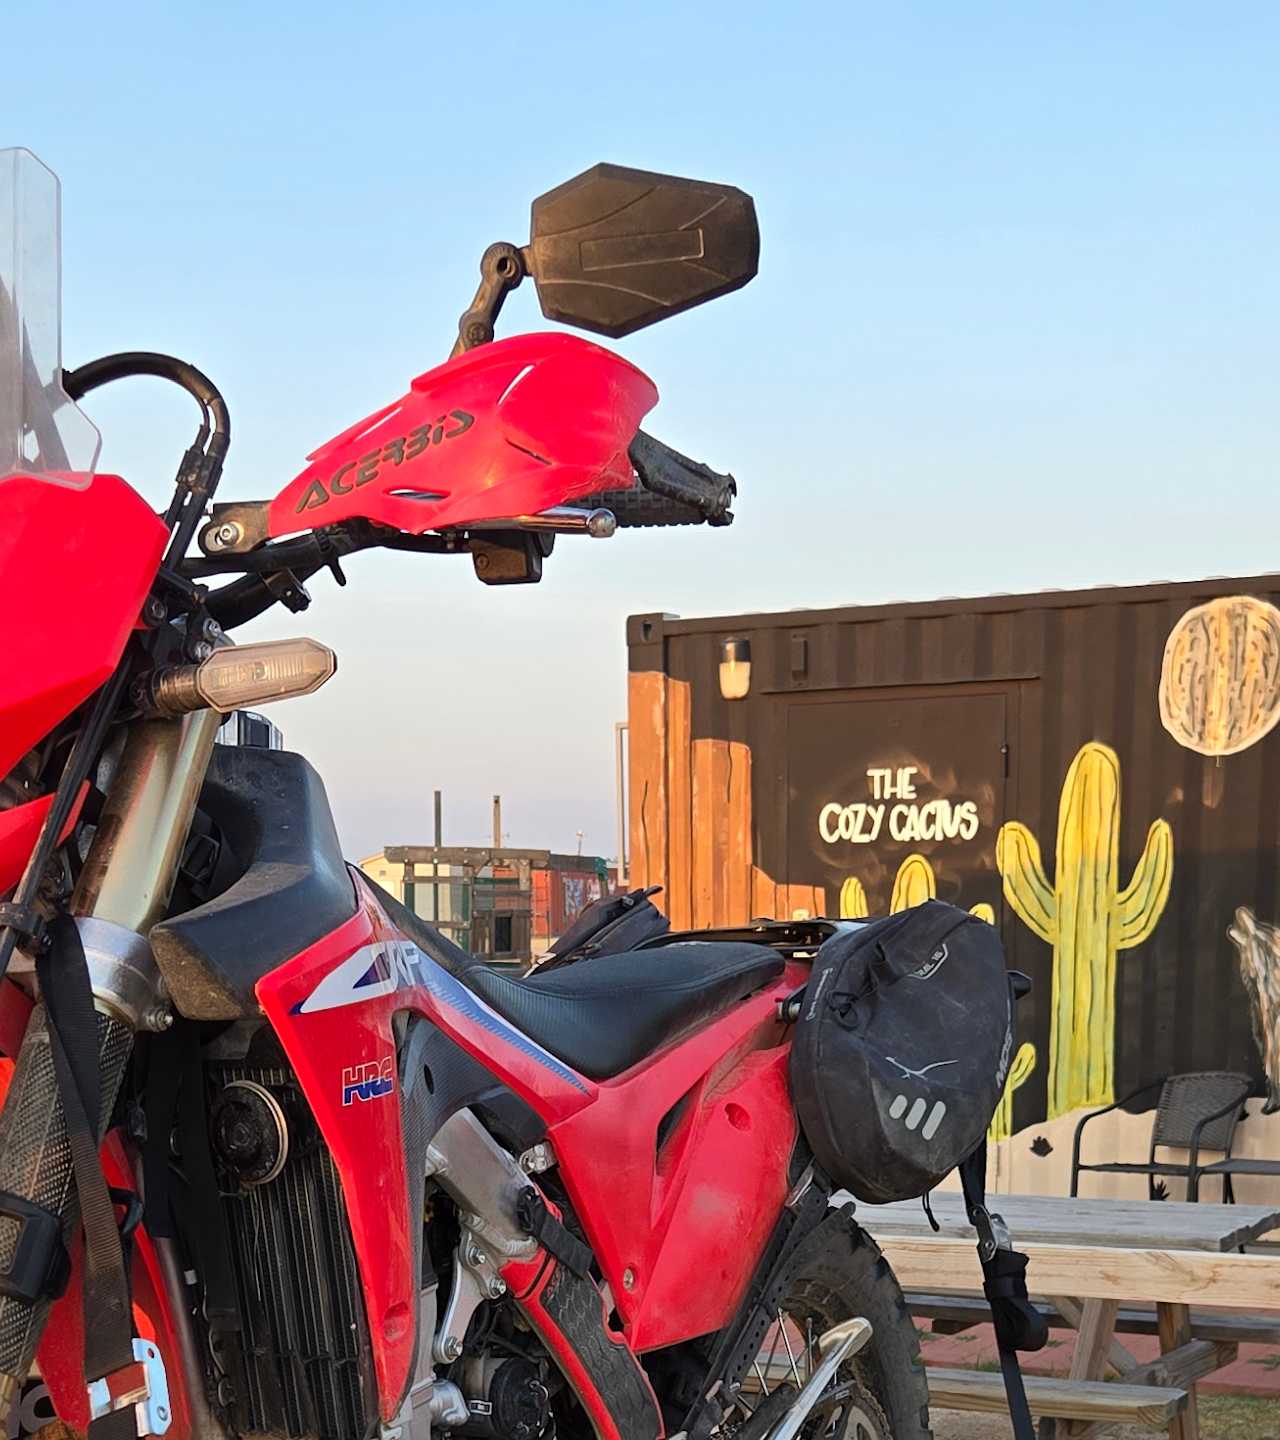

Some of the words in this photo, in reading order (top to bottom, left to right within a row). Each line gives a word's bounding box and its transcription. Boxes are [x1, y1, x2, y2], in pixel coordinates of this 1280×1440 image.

[295, 408, 476, 514] ACERBIS
[866, 766, 918, 800] THE
[818, 802, 886, 844] COZY
[888, 799, 980, 842] CACTUS
[342, 1055, 394, 1107] HRC
